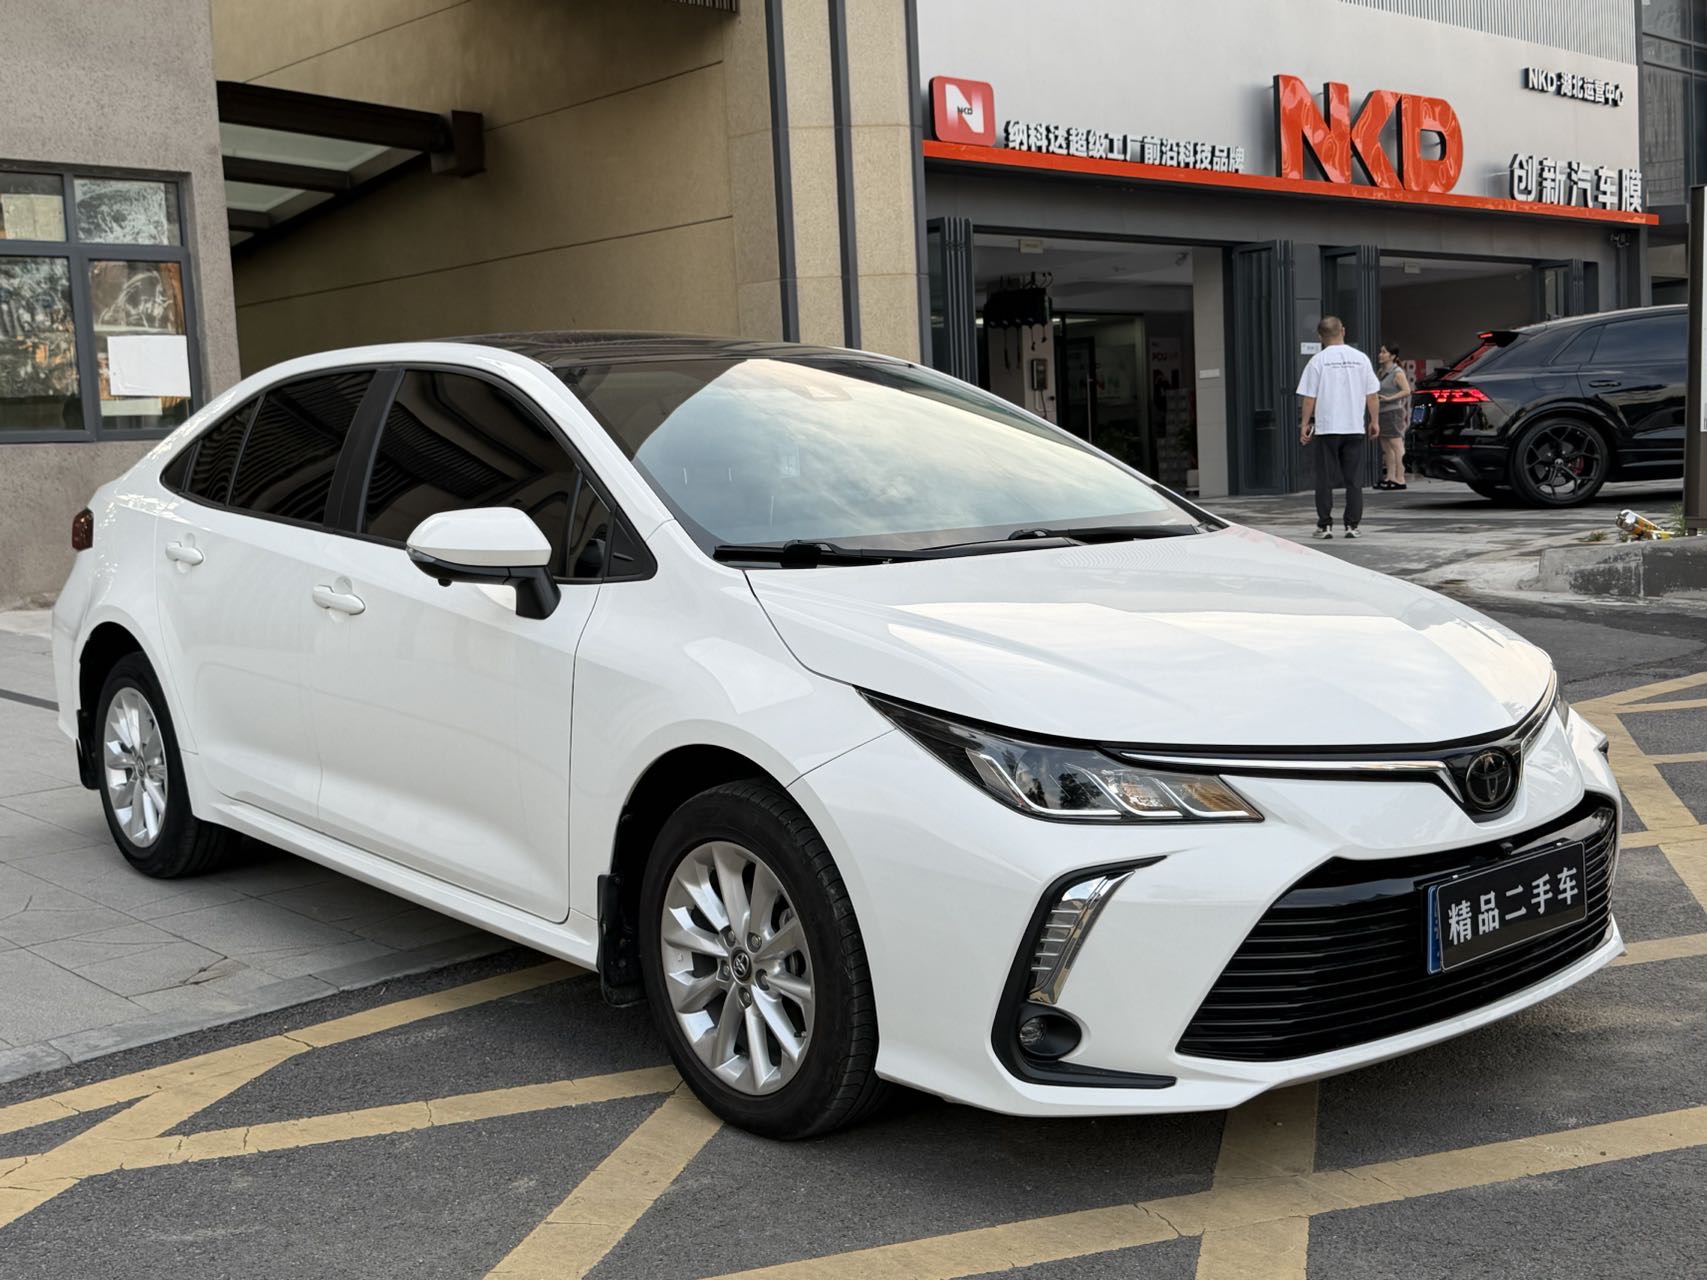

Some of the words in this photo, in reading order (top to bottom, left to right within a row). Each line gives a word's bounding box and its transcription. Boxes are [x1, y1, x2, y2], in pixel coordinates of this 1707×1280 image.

[1007, 120, 1245, 174] 纳科达超级工厂前沿科技品牌
[1275, 75, 1463, 194] NKD
[1511, 154, 1642, 213] 创新汽车膜
[1448, 866, 1579, 945] 精品二手车
